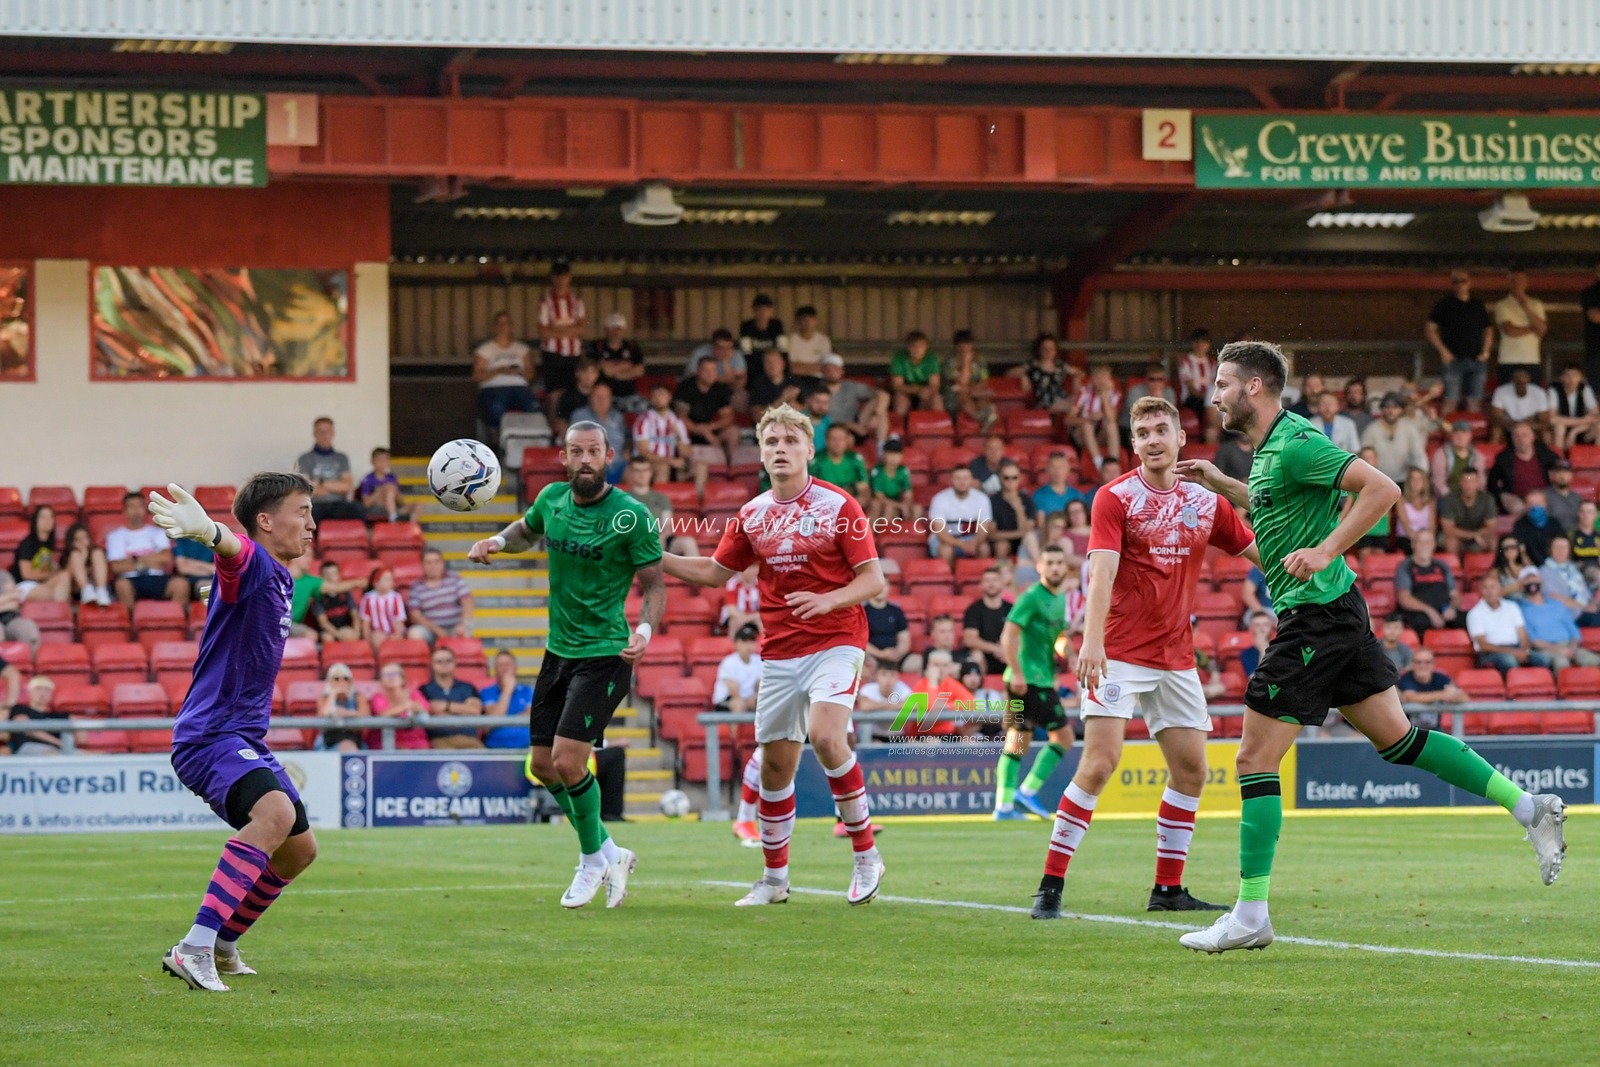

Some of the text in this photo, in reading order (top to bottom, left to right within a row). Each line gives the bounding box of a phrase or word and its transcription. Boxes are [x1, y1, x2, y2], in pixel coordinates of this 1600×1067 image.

[281, 99, 298, 140] 1
[0, 126, 217, 156] SPONSORS
[1157, 121, 1178, 148] 2
[1258, 120, 1405, 164] Crewe
[8, 155, 254, 184] MAINTENANCE
[1261, 166, 1301, 182] FOR
[1311, 166, 1369, 182] SITES
[1379, 166, 1421, 182] AND
[1427, 166, 1526, 182] PREMISES
[1535, 166, 1584, 182] RING
[867, 768, 997, 787] AMBERLAI
[1306, 780, 1422, 805] Estate Agents
[375, 796, 408, 818] ICE
[410, 796, 480, 818] CREAM
